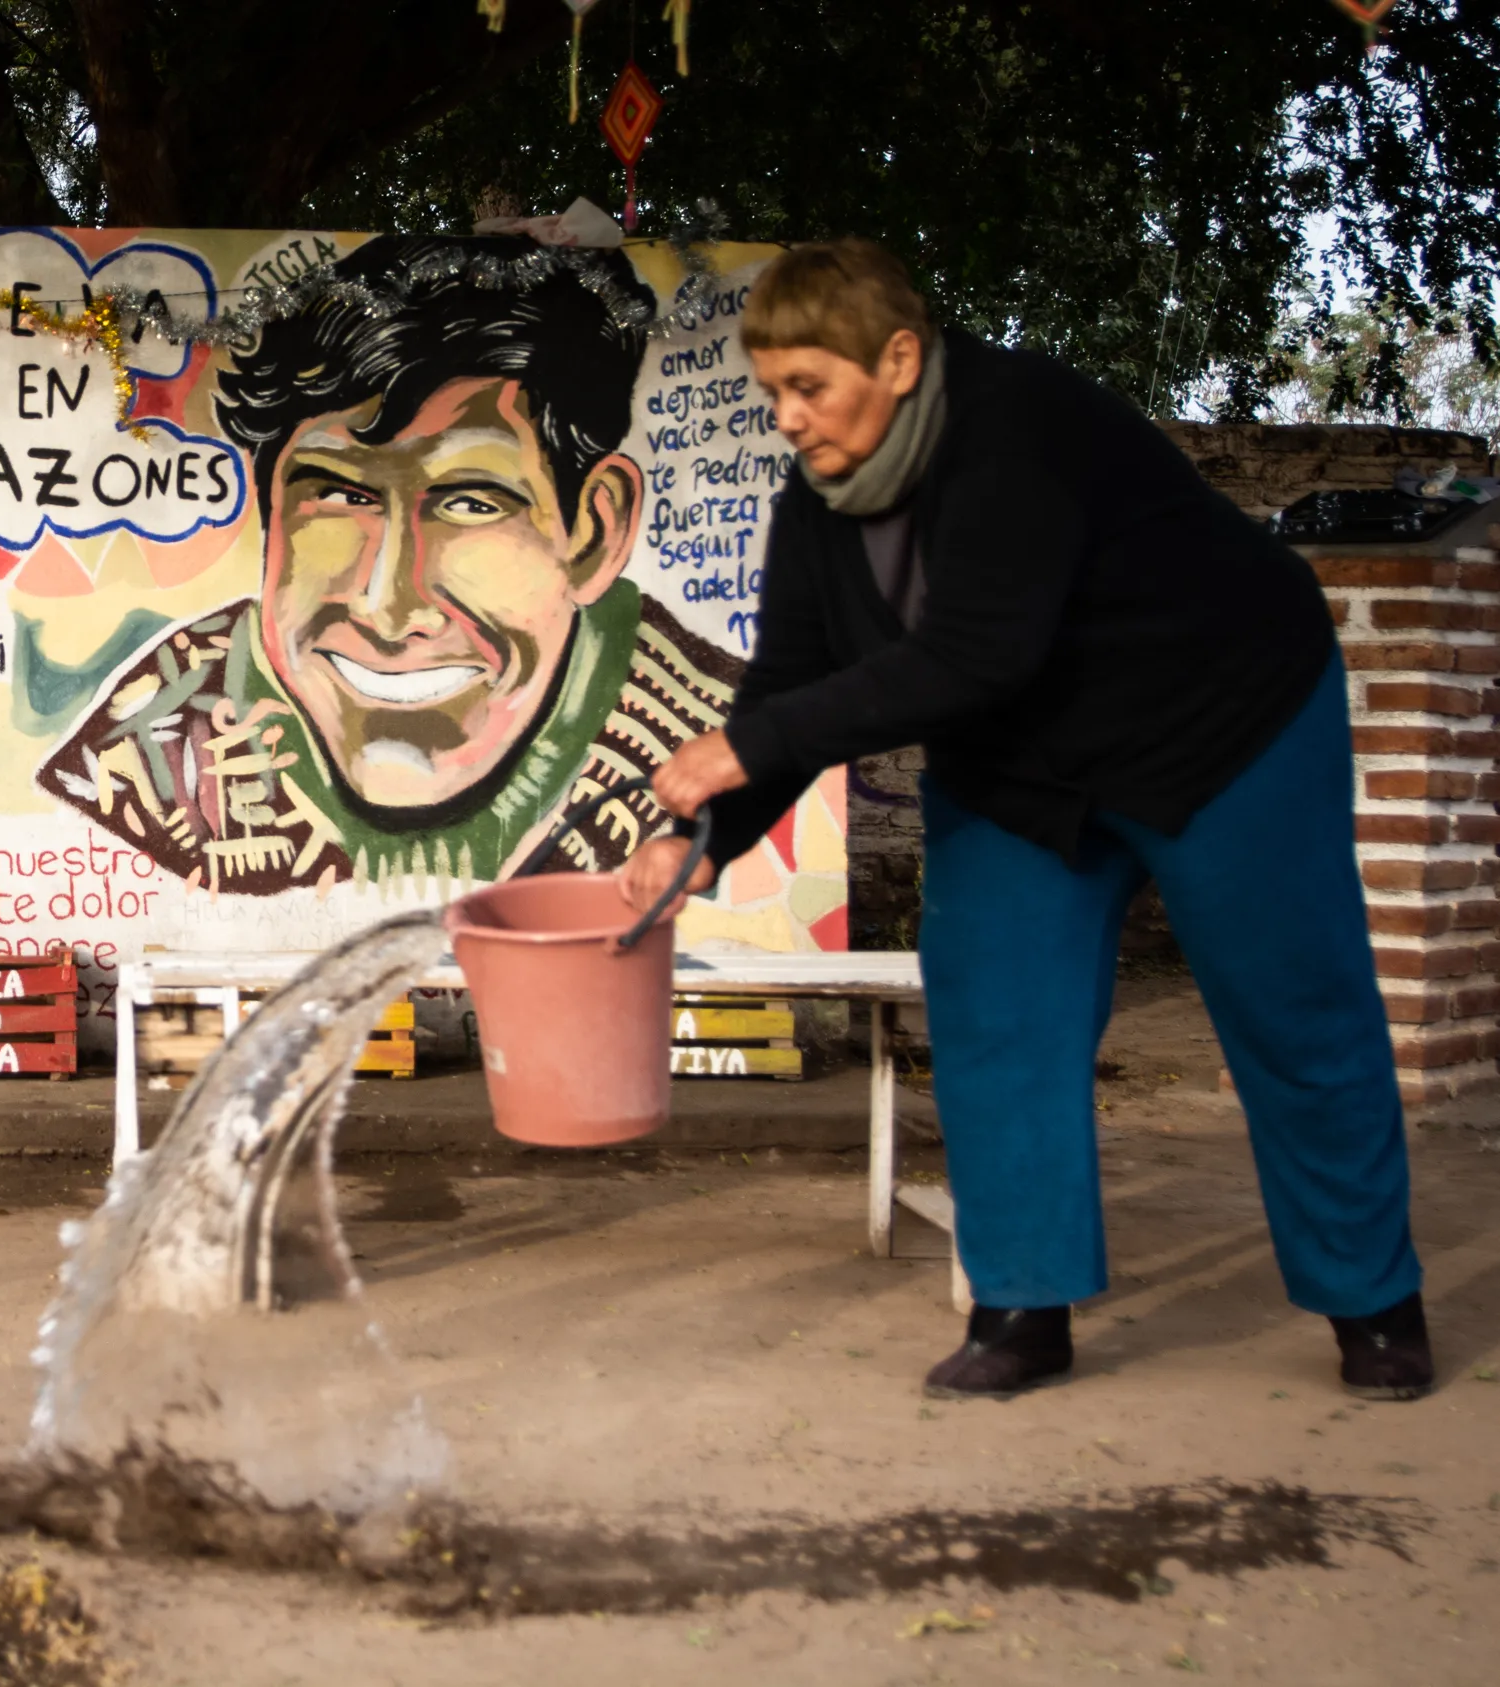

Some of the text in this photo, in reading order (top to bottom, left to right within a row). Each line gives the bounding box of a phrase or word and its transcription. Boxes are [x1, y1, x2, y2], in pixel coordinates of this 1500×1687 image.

[661, 336, 729, 377] amor
[18, 363, 90, 420] EN
[647, 461, 676, 494] te
[646, 493, 760, 548] fuerza
[659, 527, 754, 570] seguir
[49, 873, 159, 920] dolor
